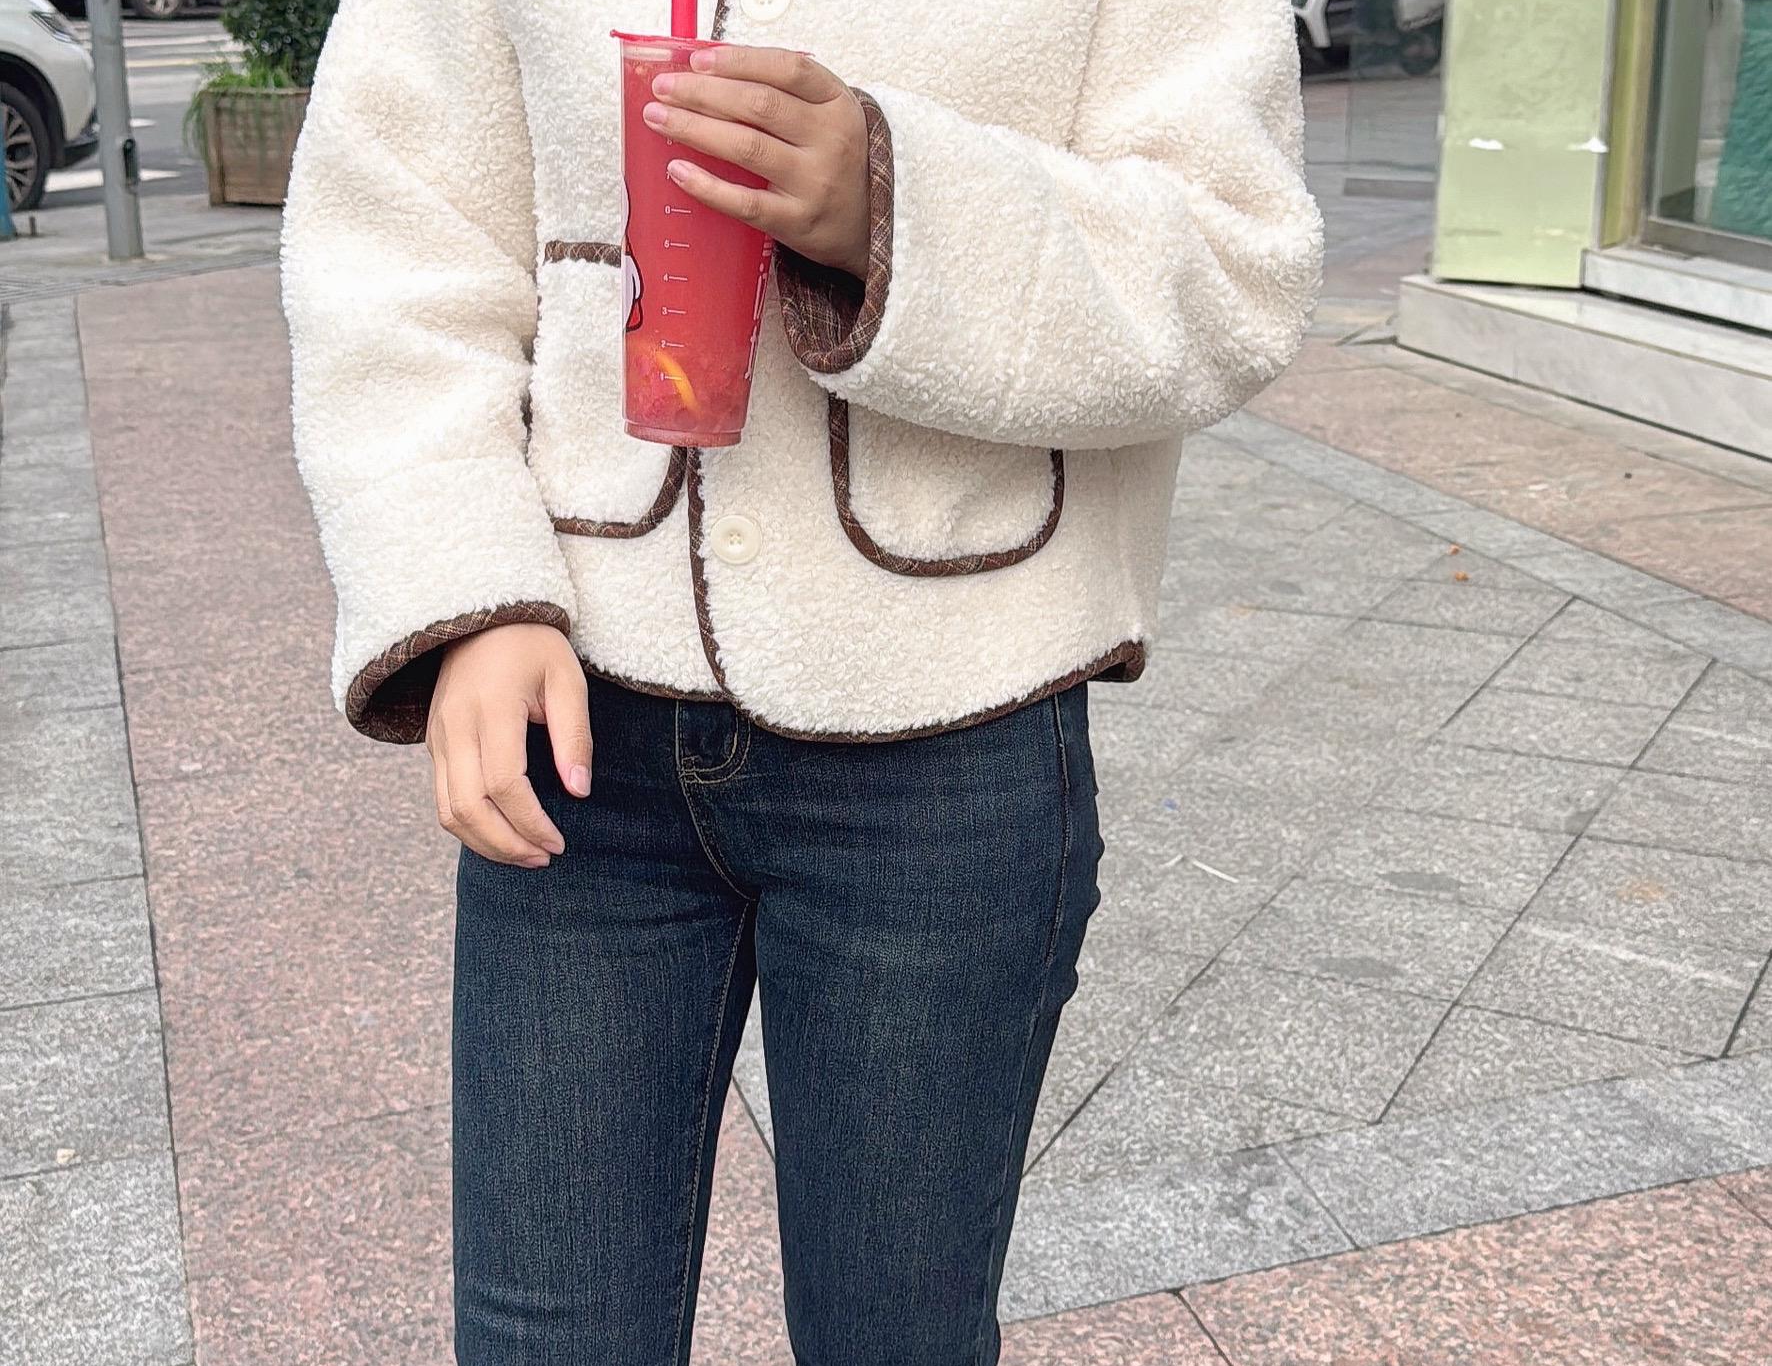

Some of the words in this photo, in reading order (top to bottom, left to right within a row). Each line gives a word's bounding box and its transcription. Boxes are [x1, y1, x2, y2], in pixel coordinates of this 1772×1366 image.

[663, 273, 669, 282] 4
[662, 307, 668, 315] 3
[661, 340, 666, 348] 2
[660, 373, 664, 381] 1
